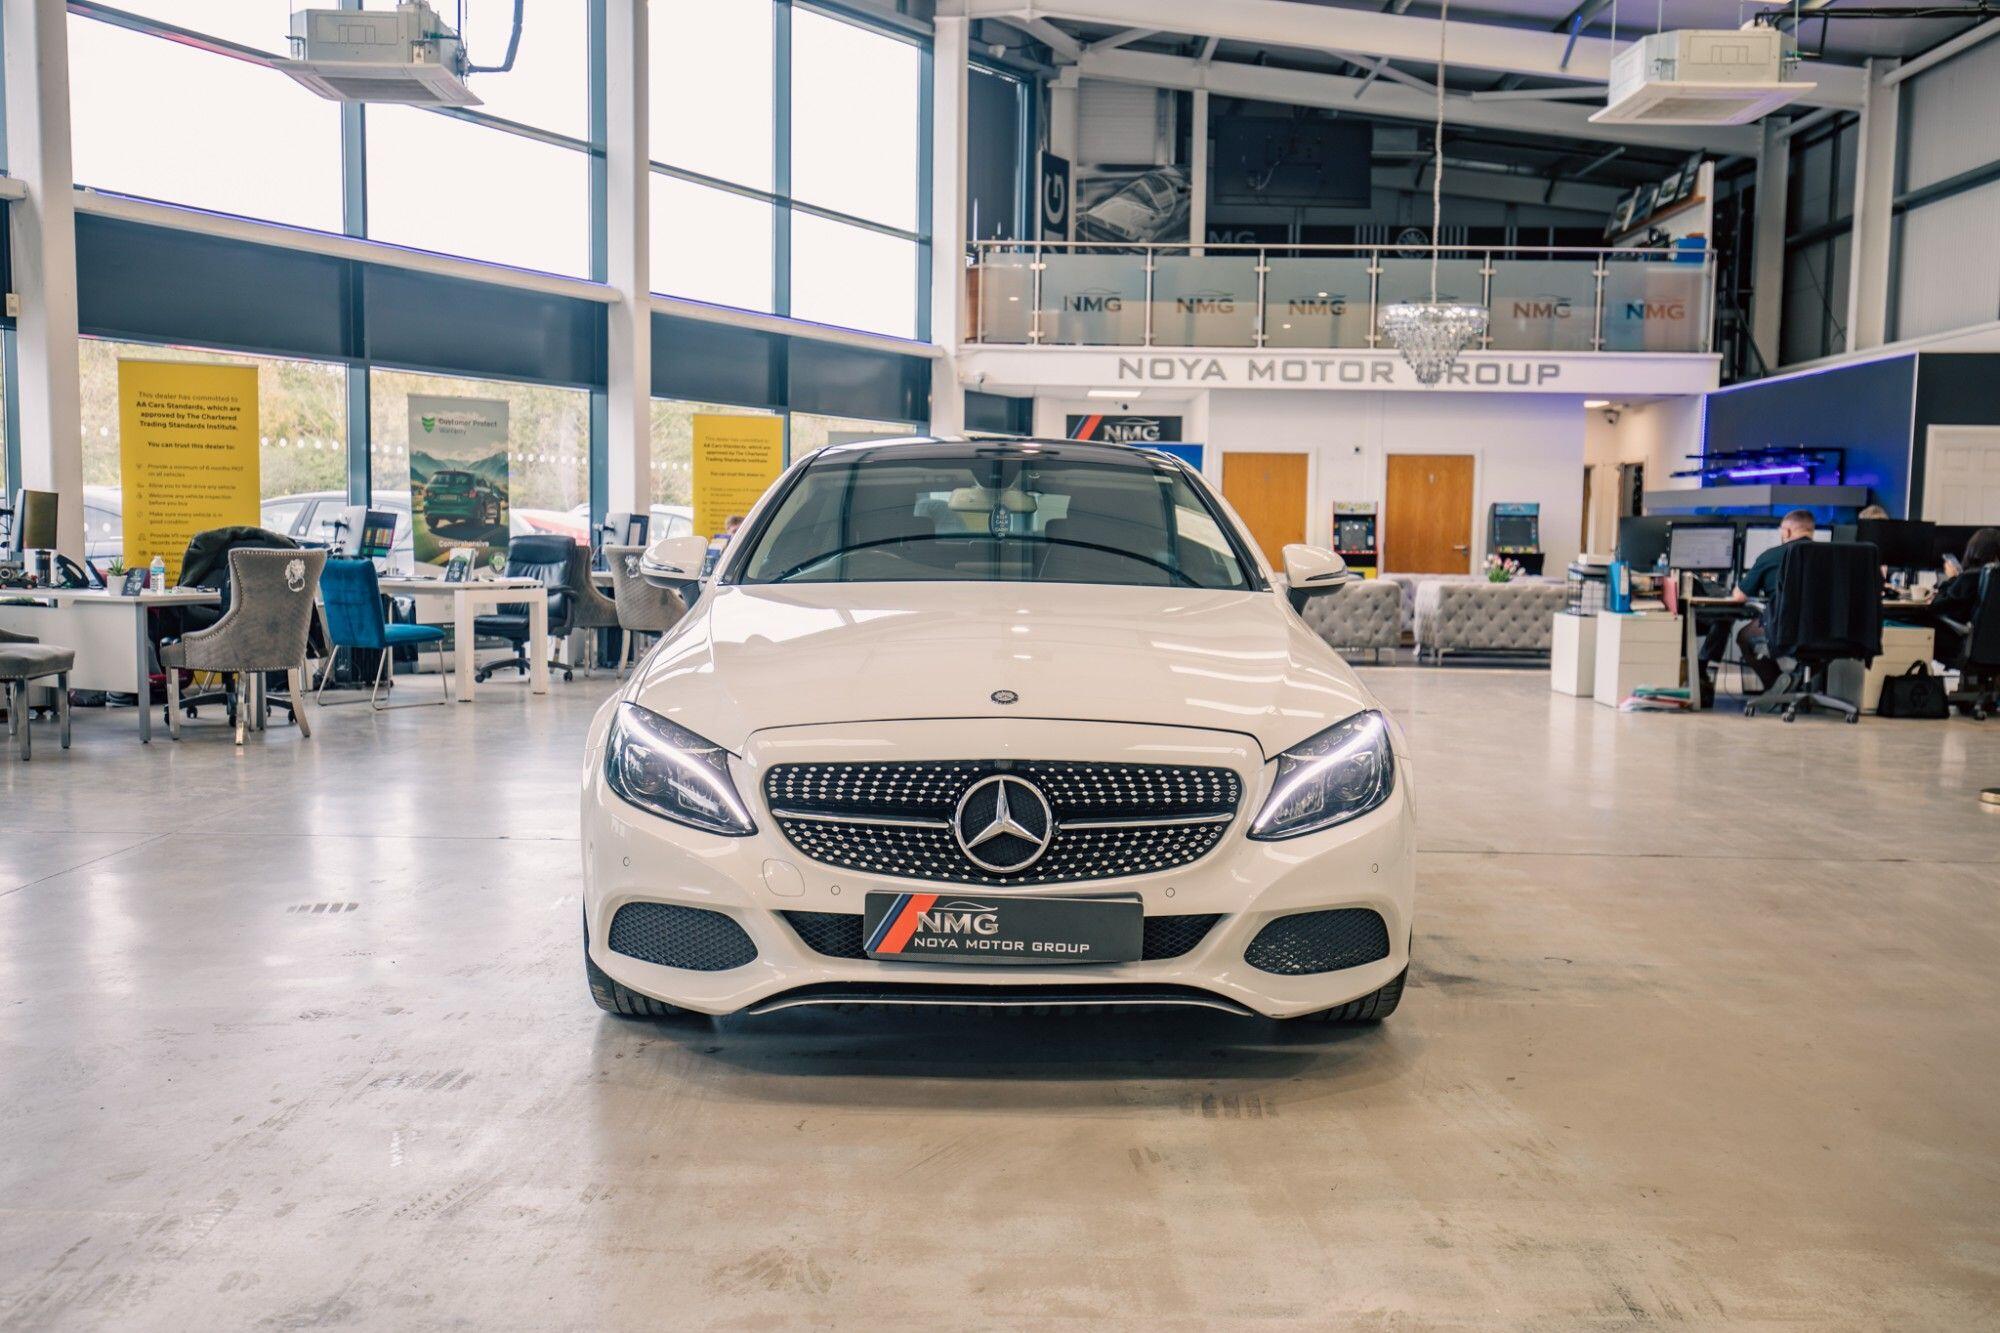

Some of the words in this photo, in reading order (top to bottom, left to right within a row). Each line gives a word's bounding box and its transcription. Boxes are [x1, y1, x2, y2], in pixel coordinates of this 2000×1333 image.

[1064, 297, 1122, 312] NMG
[1176, 298, 1235, 314] NMG
[1288, 299, 1346, 315] NMG
[1513, 302, 1571, 319] NMG
[1626, 303, 1685, 320] NMG
[1118, 357, 1227, 380] NOYA
[1248, 359, 1394, 383] MOTOR
[139, 391, 153, 399] This
[154, 392, 177, 400] dealer
[179, 393, 191, 401] has
[192, 394, 229, 402] committed
[141, 411, 175, 419] approved
[176, 412, 186, 420] by
[439, 418, 471, 426] Customer
[473, 420, 497, 428] Protect
[140, 421, 167, 429] Trading
[1104, 425, 1160, 441] NMG
[916, 911, 999, 935] NMG
[914, 937, 958, 949] NOYA
[966, 939, 1024, 951] MOTOR
[1032, 941, 1090, 953] GROUP
